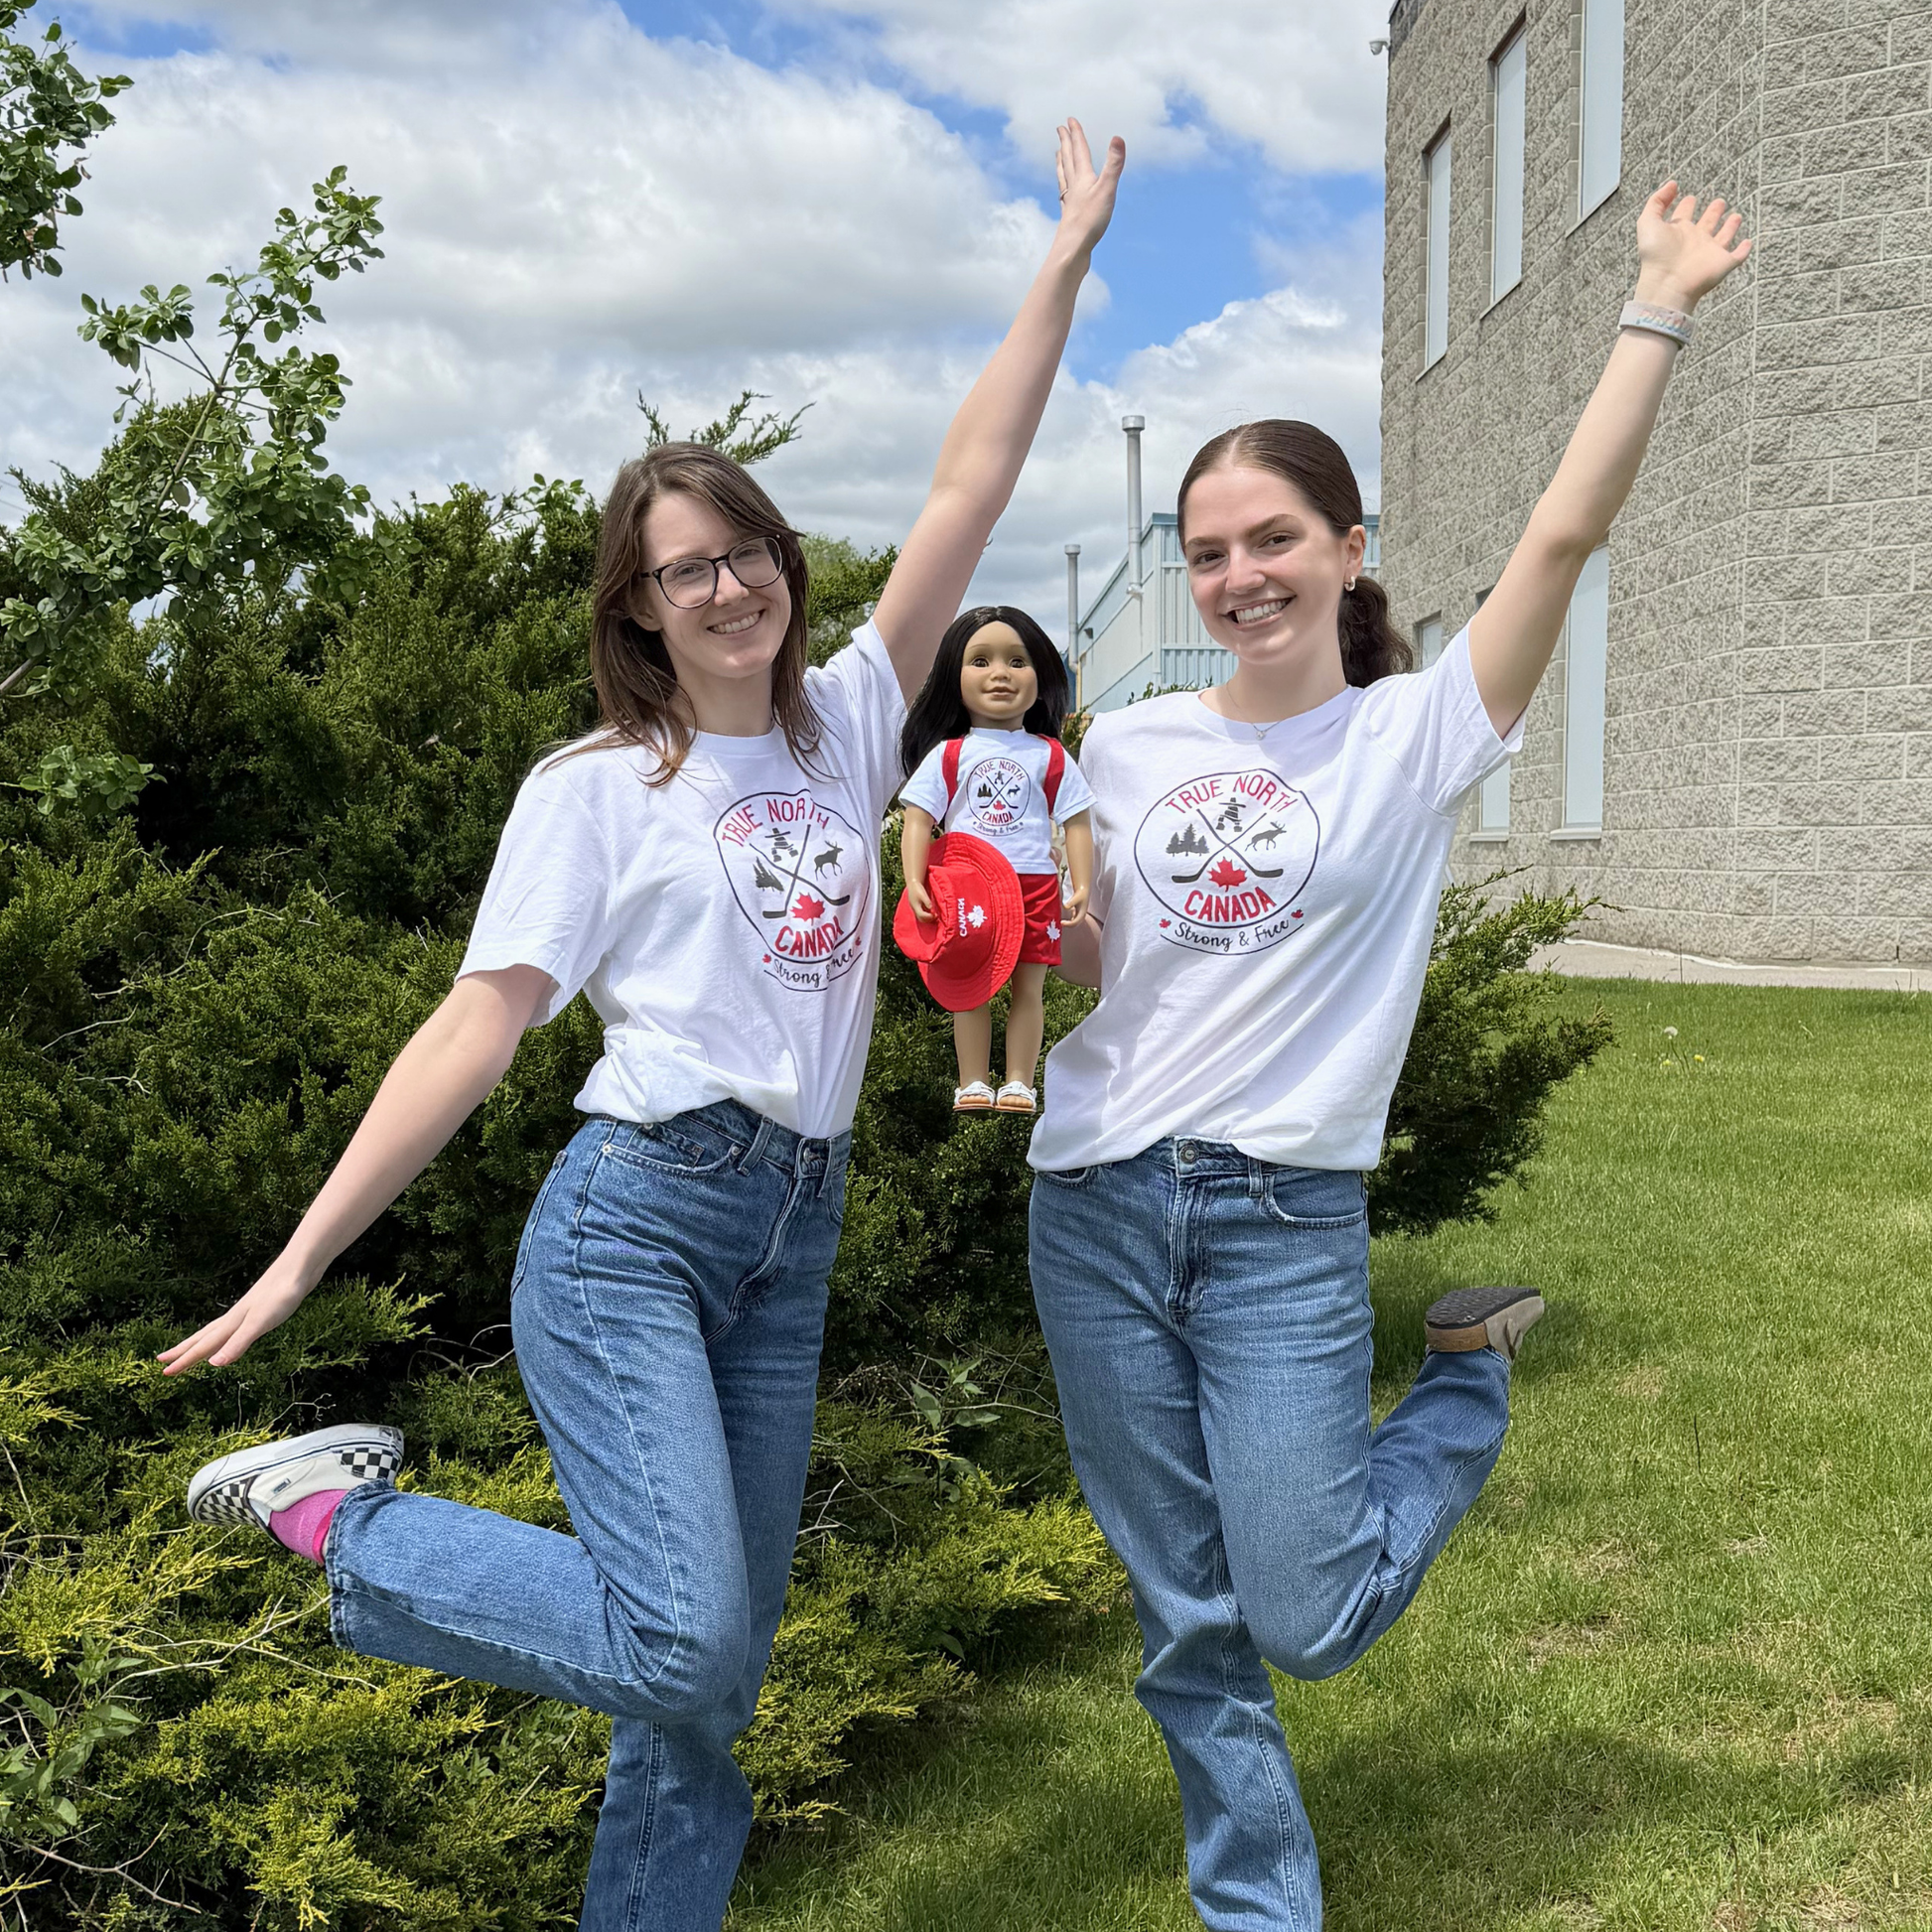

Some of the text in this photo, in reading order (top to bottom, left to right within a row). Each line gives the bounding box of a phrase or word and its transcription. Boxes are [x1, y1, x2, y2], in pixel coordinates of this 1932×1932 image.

[974, 760, 1026, 781] TRUE NORTH
[1166, 779, 1224, 814] TRUE
[722, 804, 763, 848] TRUE
[982, 811, 1015, 824] CANADA
[956, 897, 967, 937] CANADA
[1183, 886, 1277, 922] CANADA
[1174, 919, 1291, 952] Strong & Free
[772, 958, 823, 989] Strong
